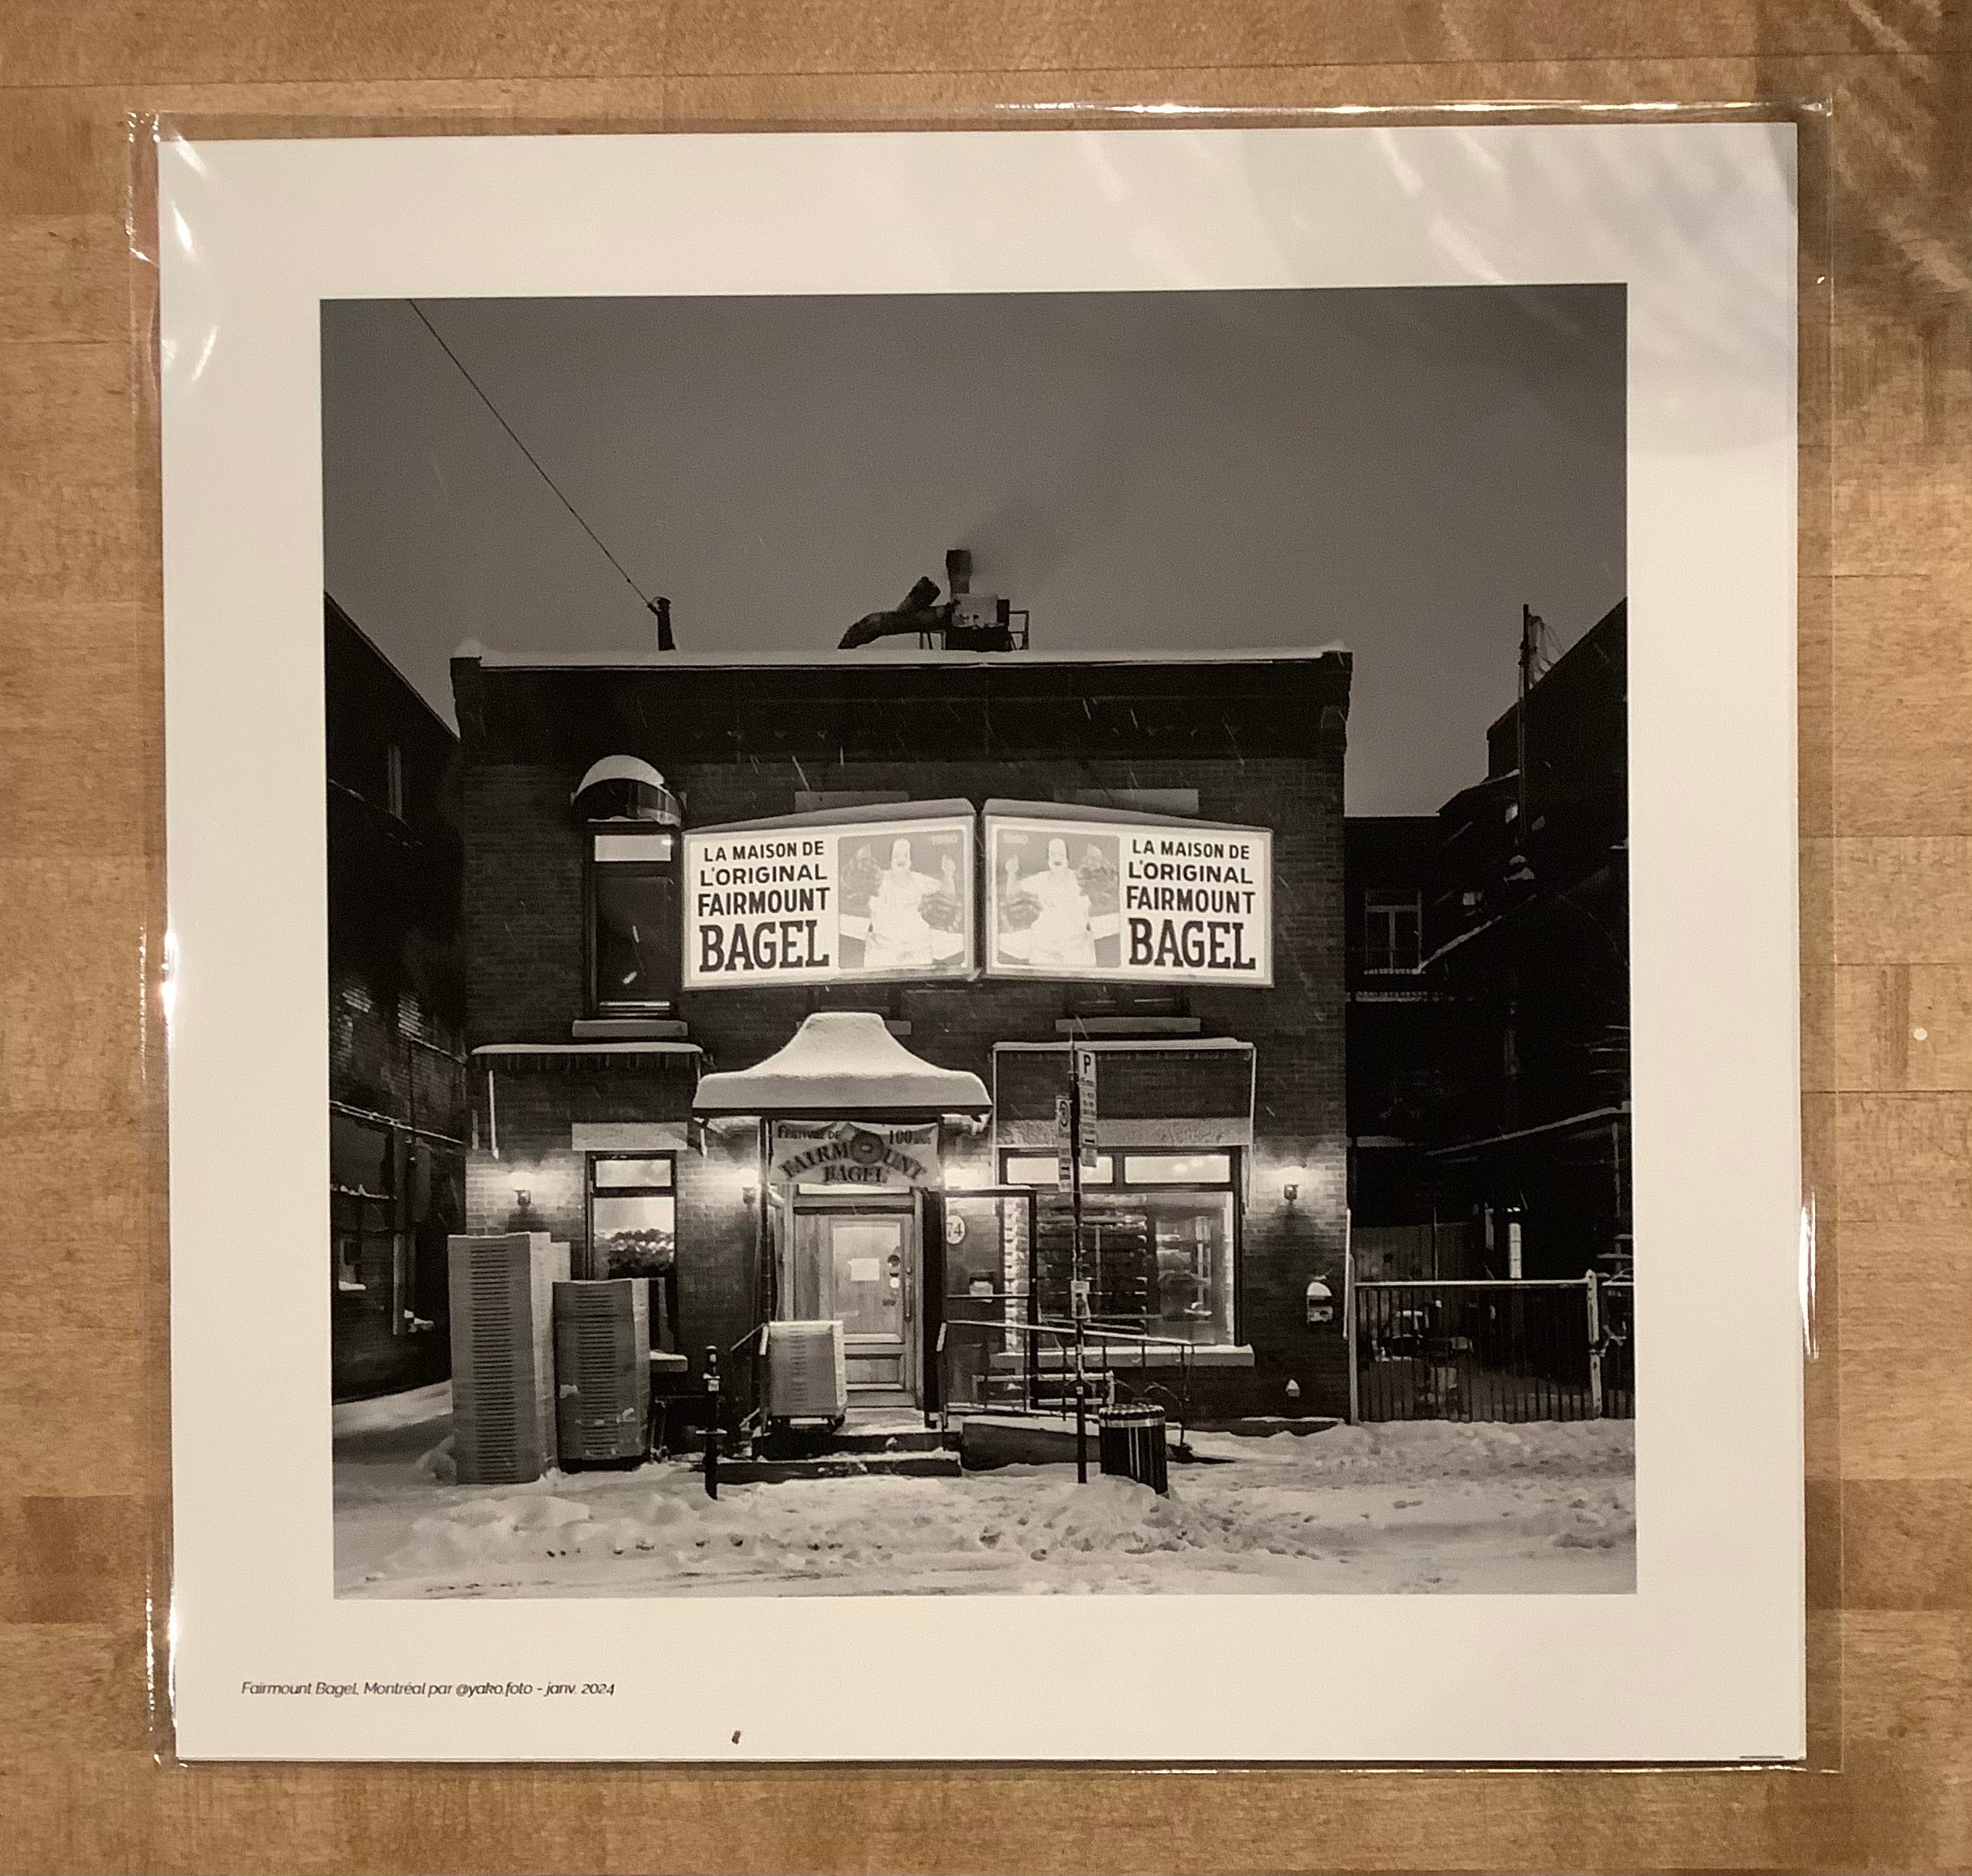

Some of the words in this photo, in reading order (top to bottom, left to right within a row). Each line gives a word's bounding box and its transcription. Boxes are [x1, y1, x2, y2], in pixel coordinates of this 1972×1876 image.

[704, 847, 727, 862] LA
[732, 841, 798, 861] MAISON
[802, 840, 824, 856] DE
[1132, 839, 1155, 855] LA
[1160, 840, 1225, 859] MAISON
[1229, 845, 1250, 861] DE
[700, 863, 828, 887] L'ORIGINAL
[1128, 859, 1254, 885] L'ORIGINAL
[697, 887, 831, 917] FAIRMOUNT
[1126, 885, 1256, 915] FAIRMOUNT
[699, 919, 830, 972] BAGEL
[1128, 917, 1257, 971] BAGEL
[1083, 1054, 1091, 1074] P
[823, 1164, 888, 1183] BAGEL
[241, 1681, 312, 1696] Fairmount
[363, 1681, 426, 1695] Montréal
[428, 1683, 452, 1698] par
[581, 1683, 616, 1696] 2024
